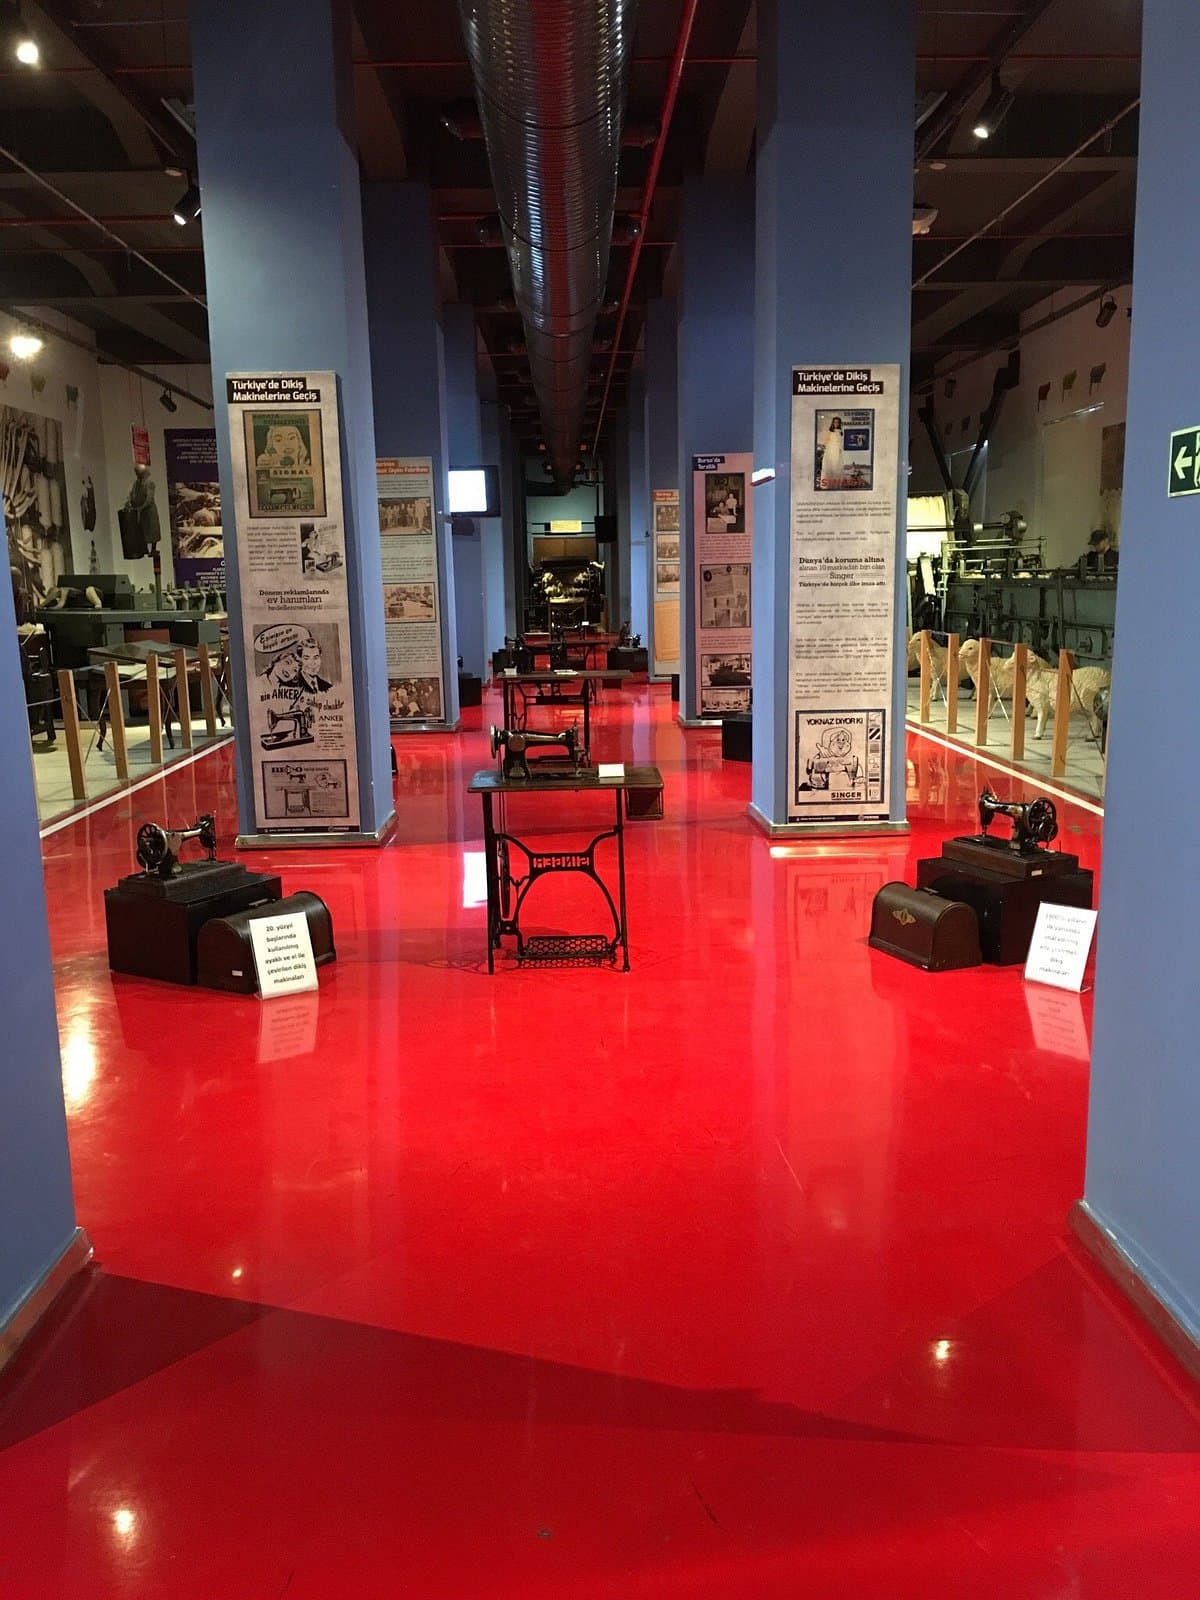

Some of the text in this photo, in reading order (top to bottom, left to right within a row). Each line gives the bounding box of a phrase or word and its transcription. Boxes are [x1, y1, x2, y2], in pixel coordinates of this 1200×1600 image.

[798, 371, 868, 383] Türkiye'de Dikiş
[232, 379, 304, 392] Türkiye'de Dikiş
[797, 383, 881, 394] Makinelerine Geçiş
[233, 391, 317, 402] Makinelerine Geçiş
[829, 572, 854, 580] Singer
[319, 714, 344, 722] ANKER
[266, 933, 297, 943] başlarında
